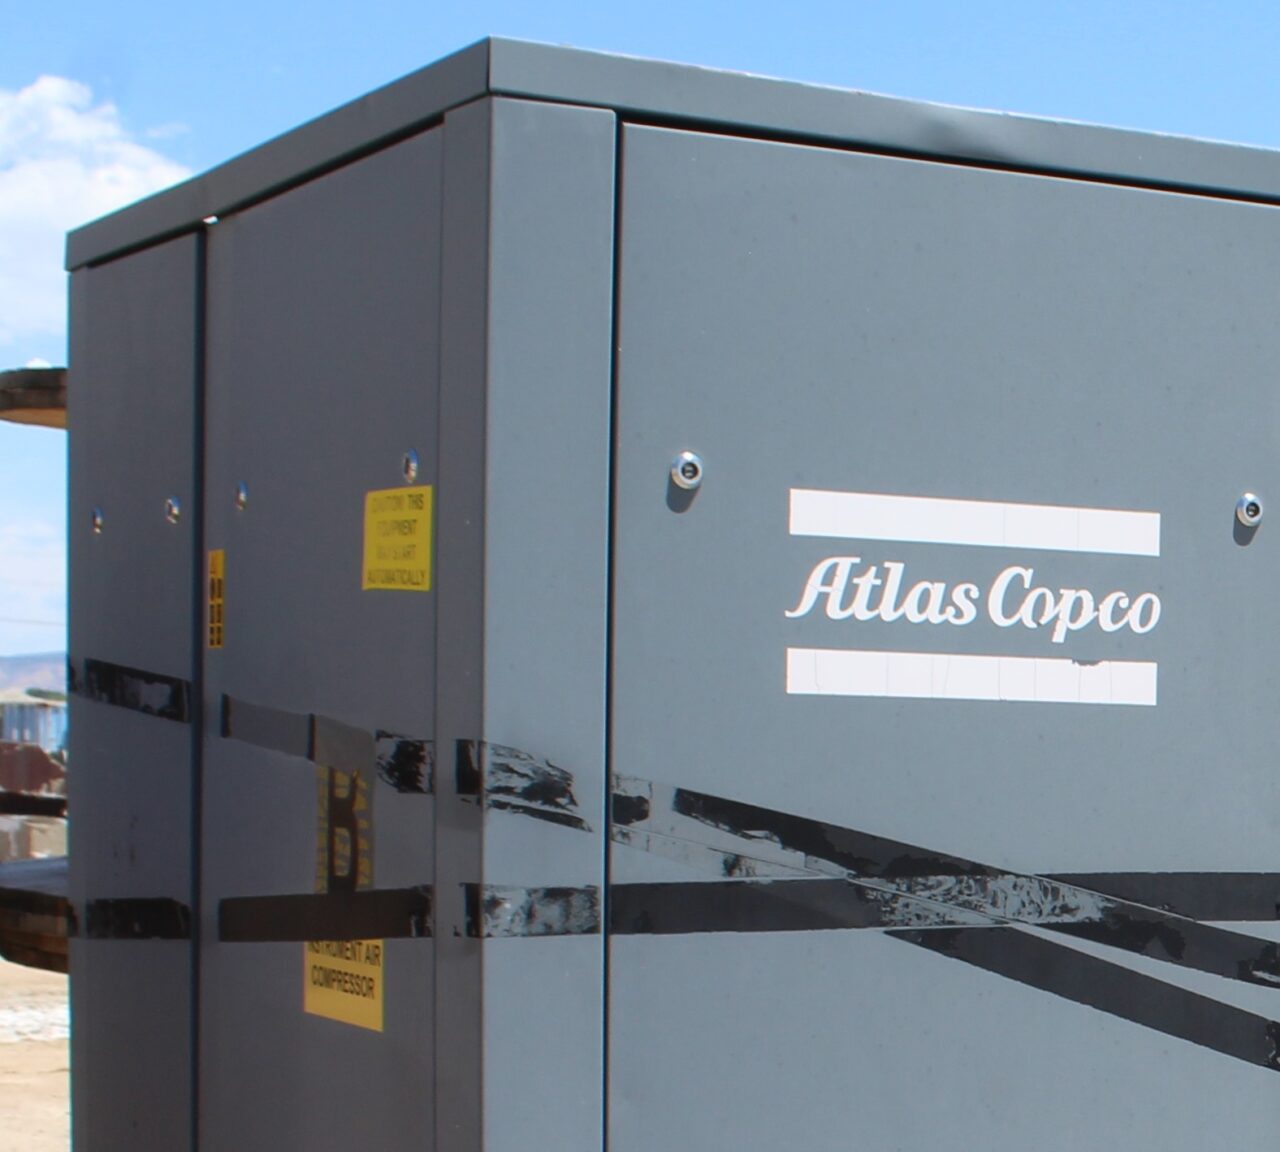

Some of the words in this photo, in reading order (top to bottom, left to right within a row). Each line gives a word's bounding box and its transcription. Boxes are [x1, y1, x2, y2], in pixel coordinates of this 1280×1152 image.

[784, 555, 980, 626] Atlas
[987, 565, 1161, 643] Copco
[365, 943, 381, 967] AIR
[312, 965, 375, 1000] COMPRESSOR
